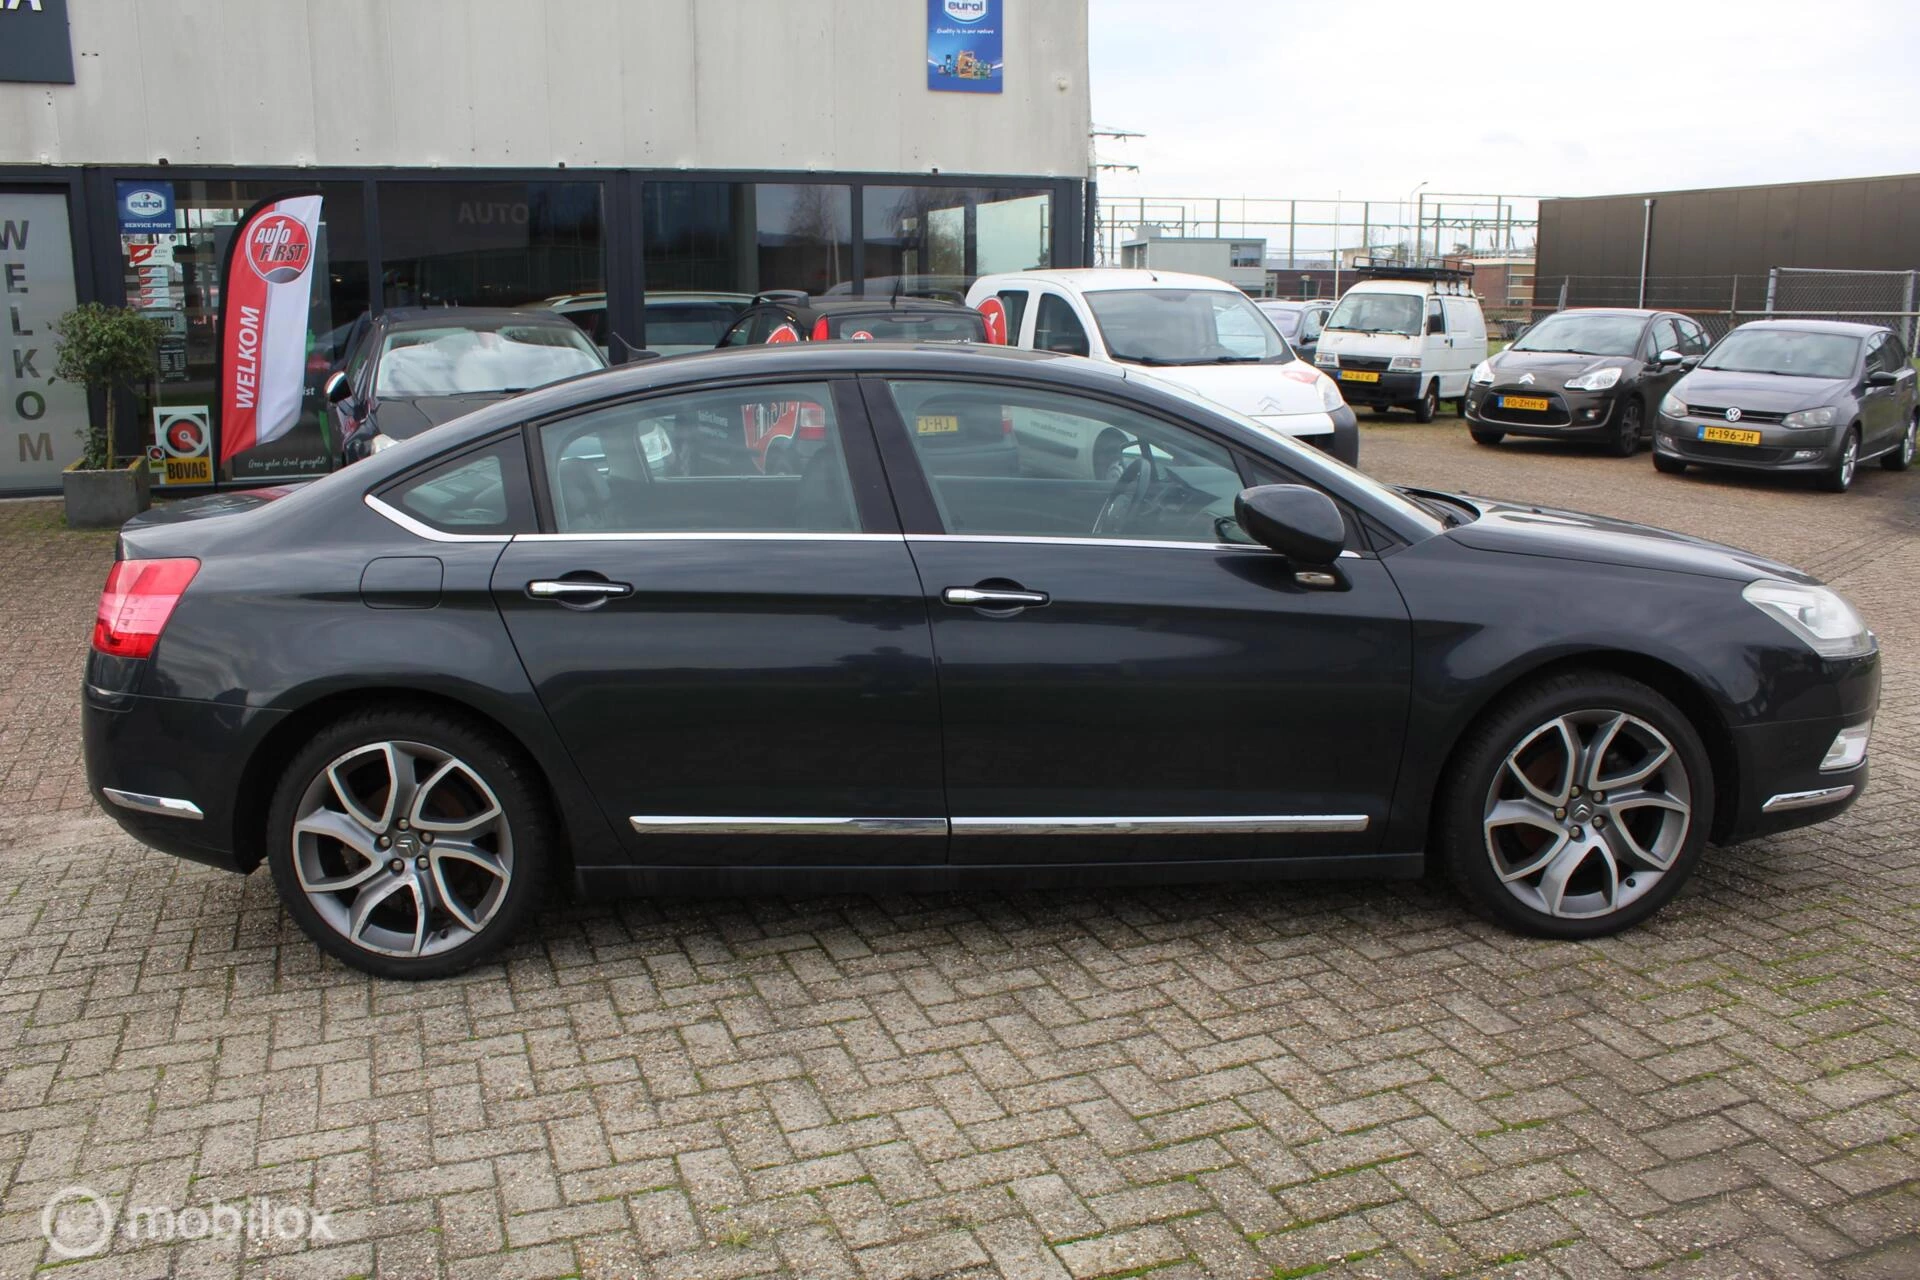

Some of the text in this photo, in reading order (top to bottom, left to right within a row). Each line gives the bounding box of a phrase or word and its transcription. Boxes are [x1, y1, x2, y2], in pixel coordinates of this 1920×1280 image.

[948, 1, 983, 11] eurol
[130, 199, 163, 209] eurol
[457, 202, 530, 225] AUTO
[0, 220, 54, 461] WELKOM
[235, 305, 260, 409] WELKOM
[1708, 428, 1754, 442] H-196-JH
[167, 462, 207, 479] BOVAG
